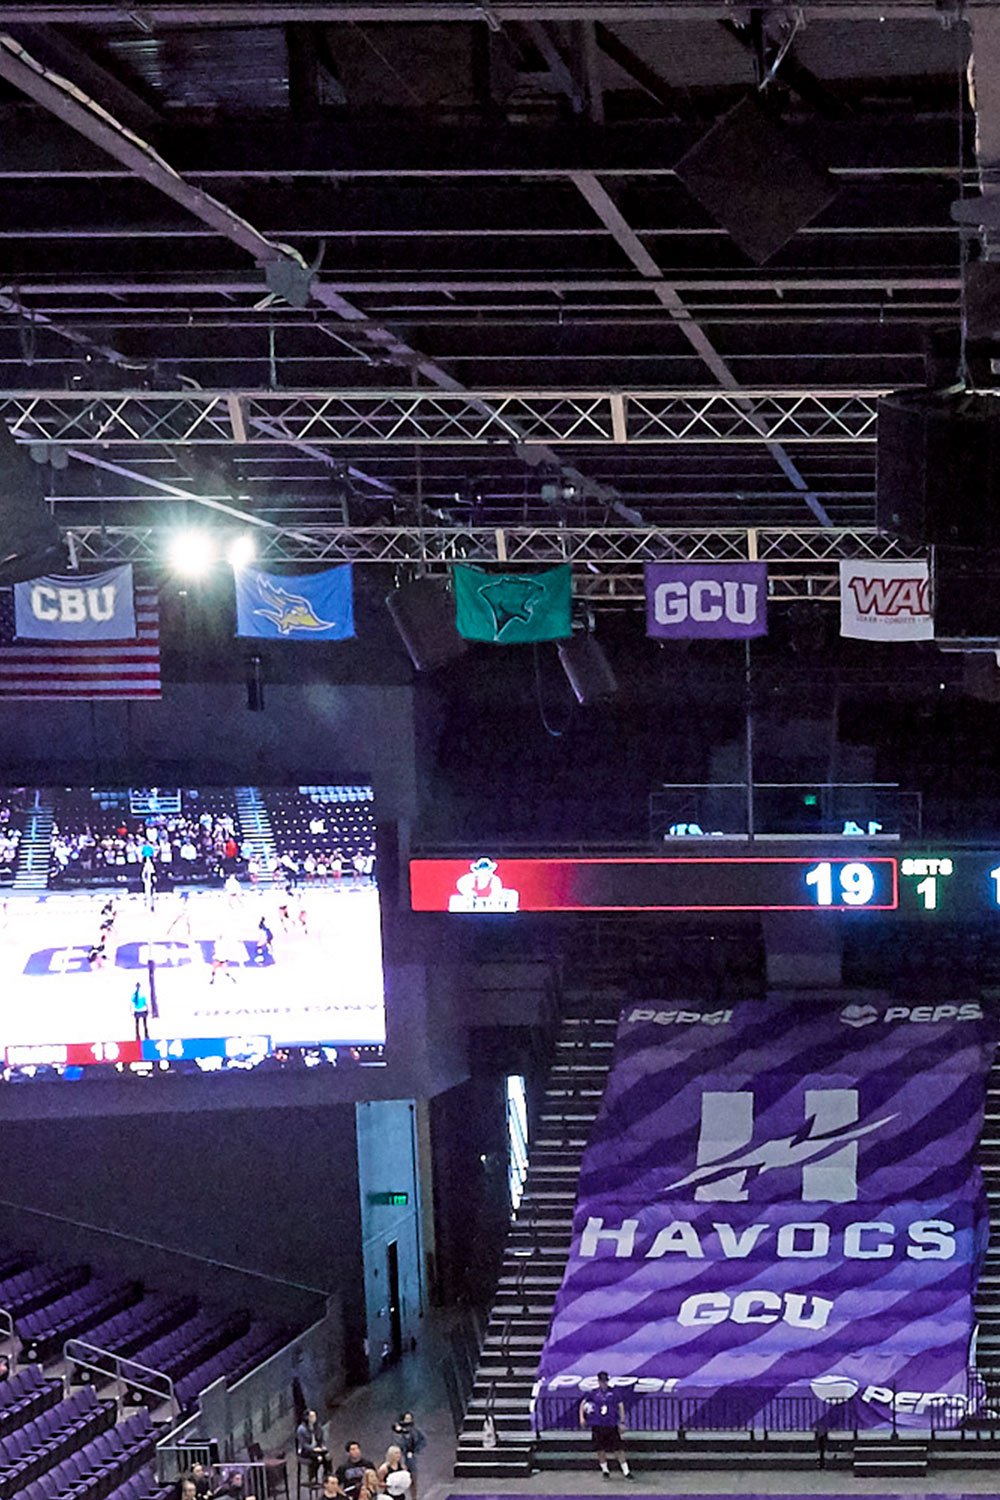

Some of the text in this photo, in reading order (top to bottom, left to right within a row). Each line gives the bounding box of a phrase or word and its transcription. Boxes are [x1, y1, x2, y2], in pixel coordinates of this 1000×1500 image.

[31, 585, 118, 622] CBU
[654, 580, 757, 624] GCU
[806, 861, 875, 906] 19
[917, 877, 938, 910] 1
[883, 1003, 983, 1022] PEPS
[579, 1216, 957, 1261] HAVOCS
[676, 1290, 834, 1330] GCU
